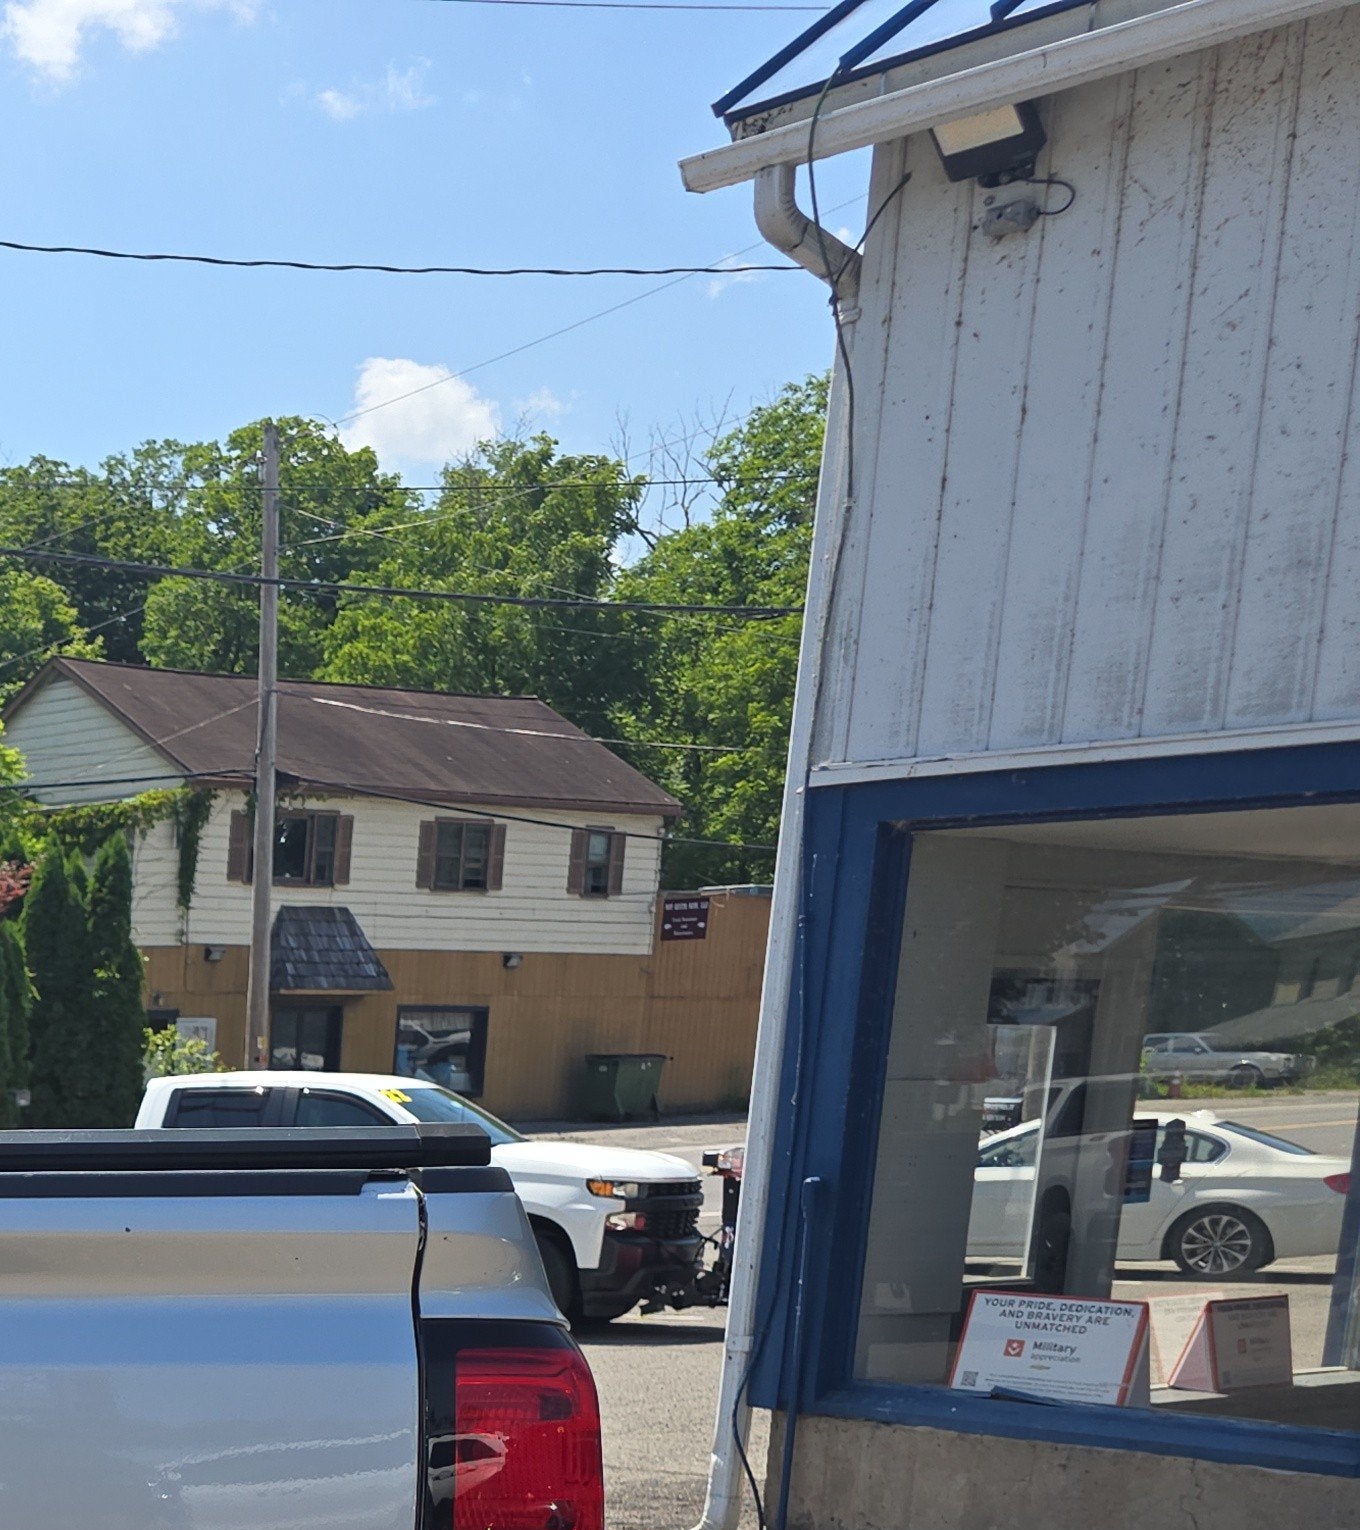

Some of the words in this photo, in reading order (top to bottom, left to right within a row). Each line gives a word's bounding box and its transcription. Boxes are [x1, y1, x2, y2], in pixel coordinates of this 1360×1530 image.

[984, 1297, 1016, 1309] YOUR
[1059, 1302, 1135, 1318] DEDICATION,
[999, 1309, 1024, 1319] AND
[1027, 1311, 1084, 1324] BRAVERY
[1085, 1316, 1110, 1326] ARE
[1014, 1320, 1088, 1335] UNMATCHED
[1032, 1341, 1078, 1356] Military
